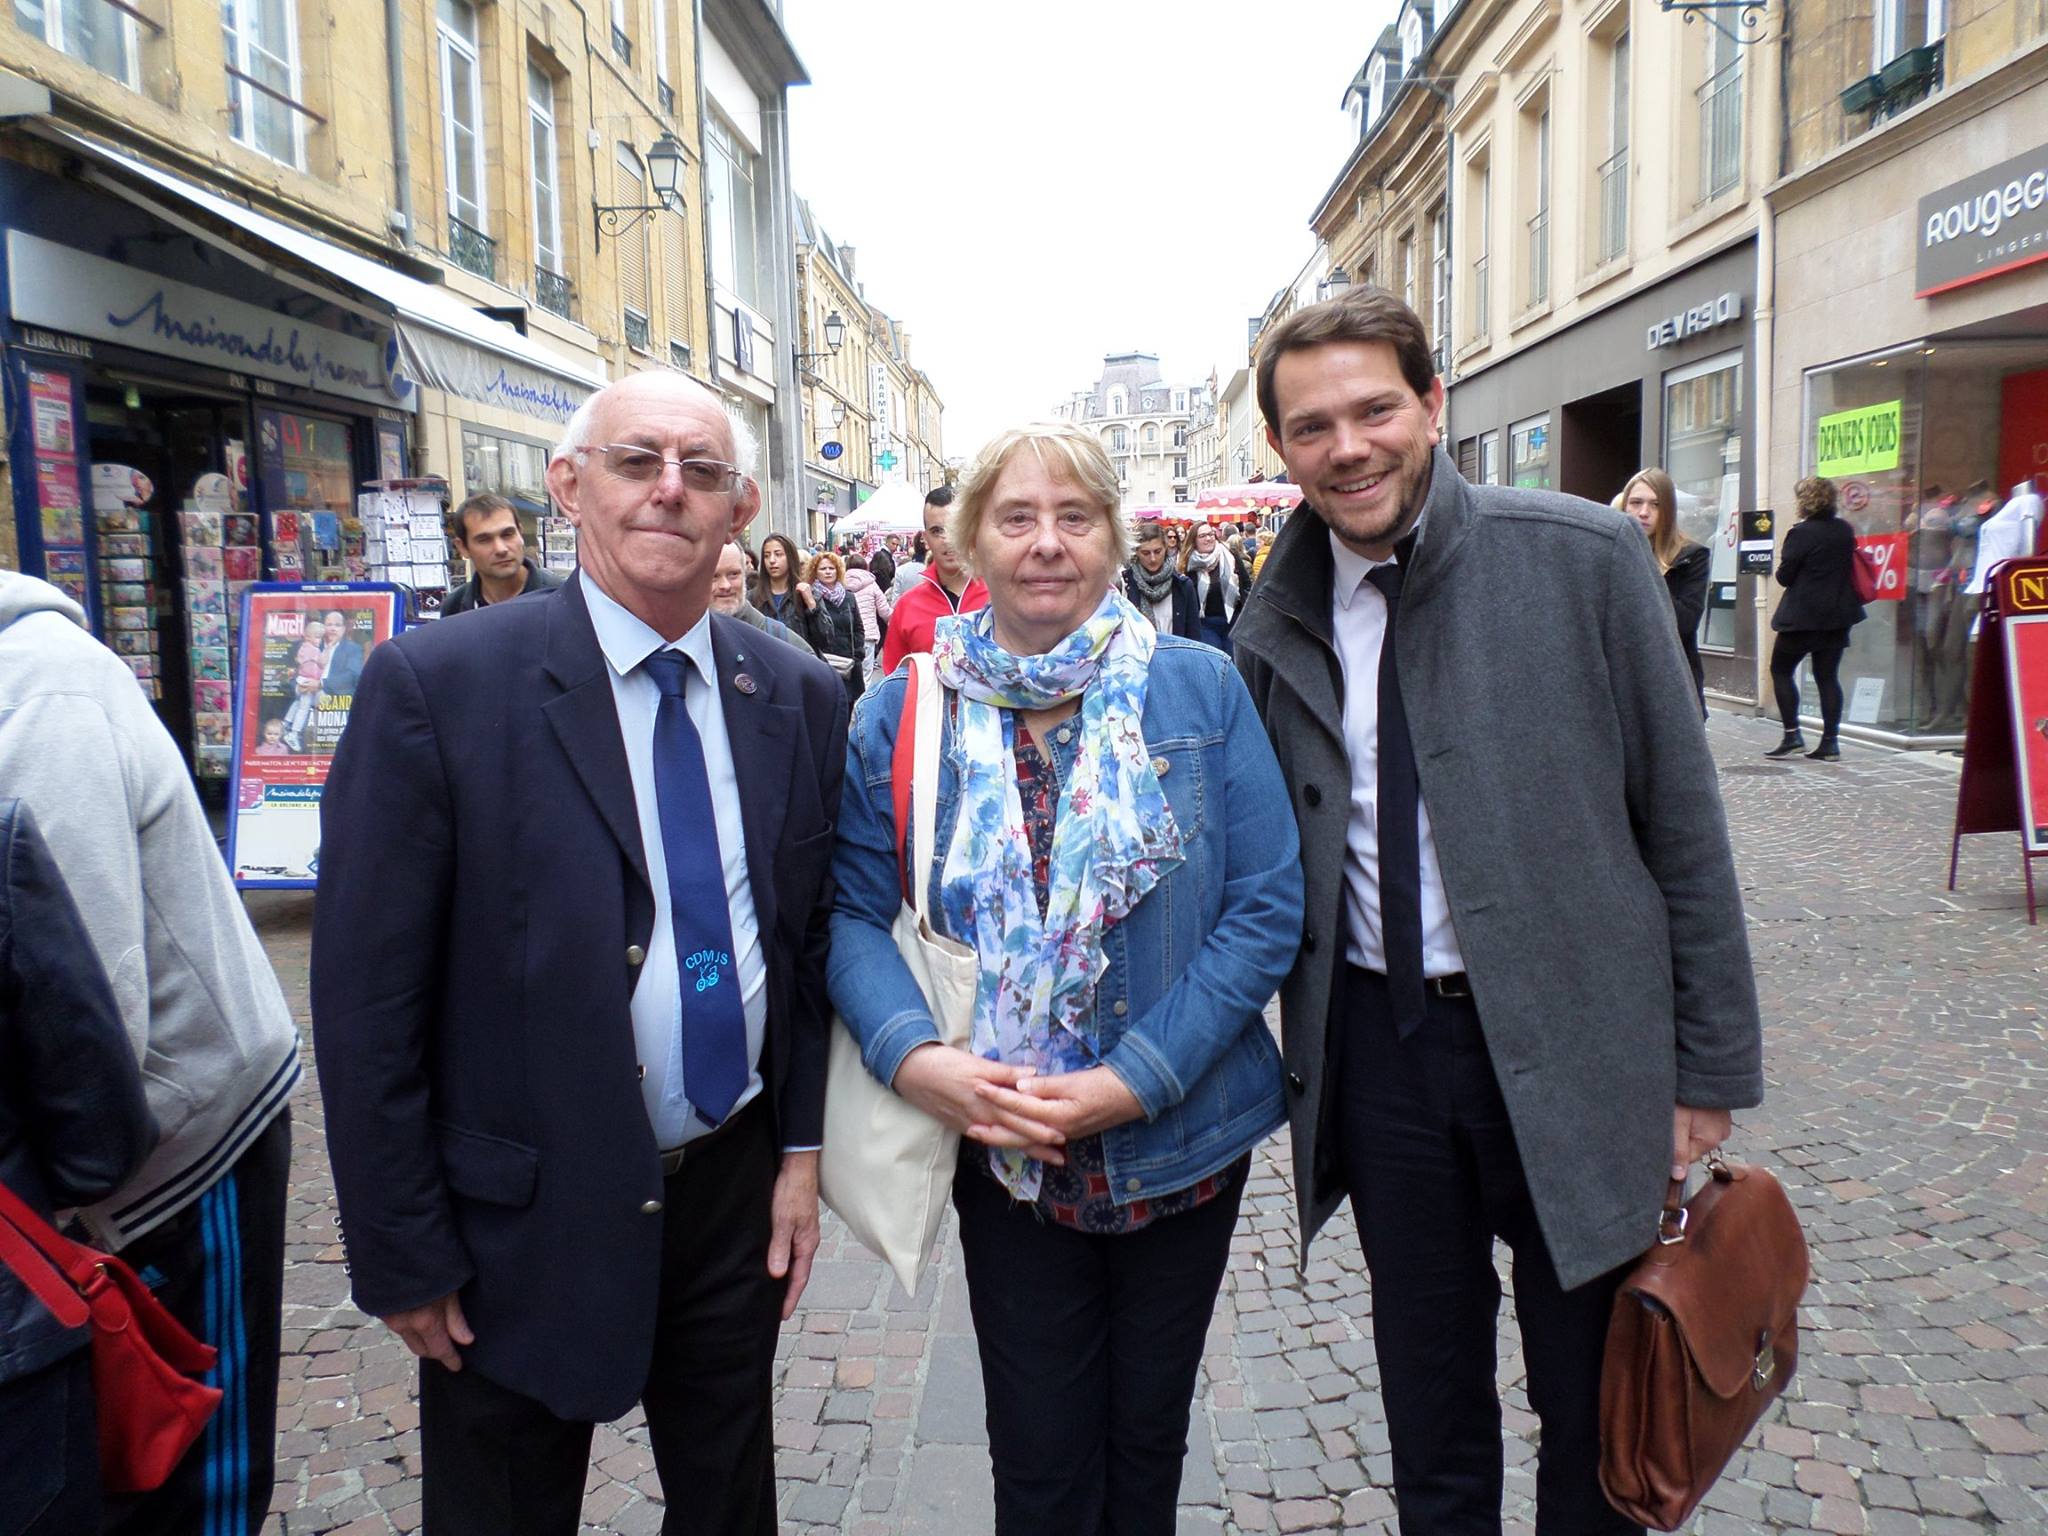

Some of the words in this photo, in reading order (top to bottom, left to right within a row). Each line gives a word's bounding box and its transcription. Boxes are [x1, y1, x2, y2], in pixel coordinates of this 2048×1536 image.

[1647, 292, 1741, 351] DEVRED
[23, 328, 93, 359] LIBRAIRIE
[877, 366, 887, 440] PHARMACIE
[1819, 418, 1864, 463] DERNIERS
[1864, 411, 1897, 464] JOURS
[267, 614, 304, 636] MATCH
[318, 711, 350, 727] MONA
[685, 950, 729, 969] CDMJS
